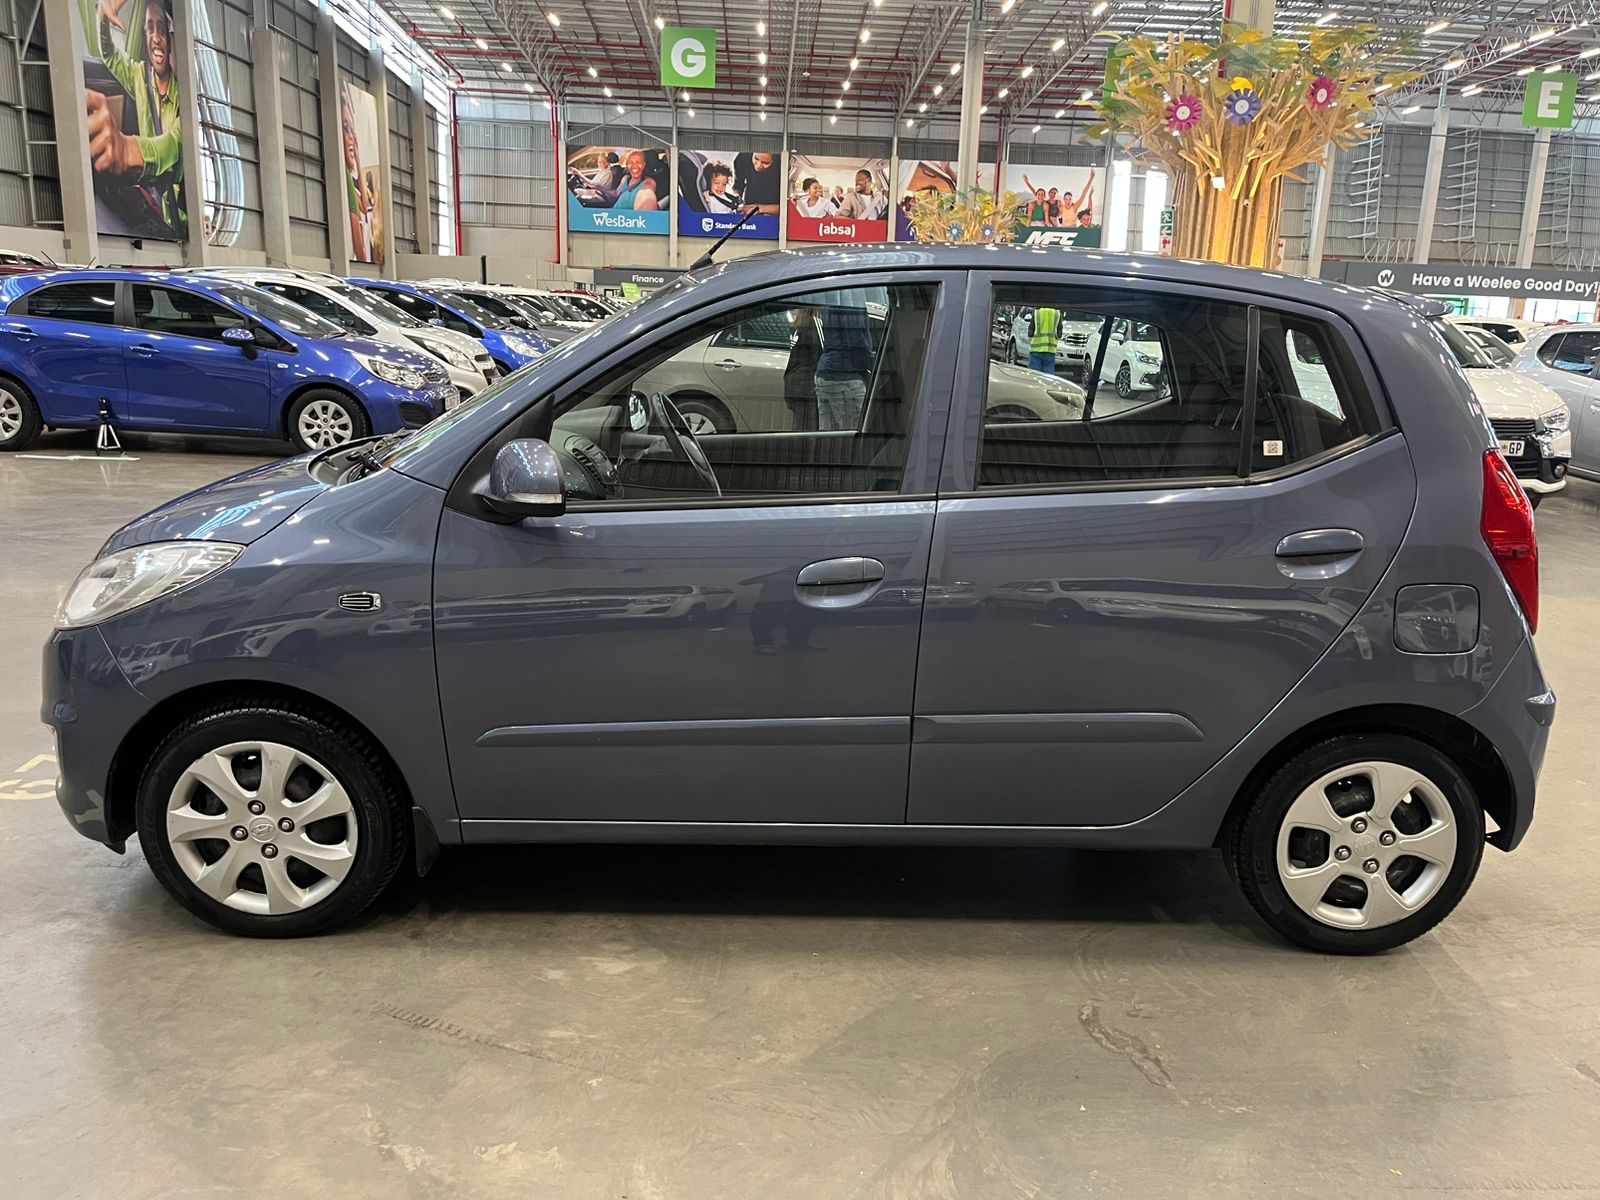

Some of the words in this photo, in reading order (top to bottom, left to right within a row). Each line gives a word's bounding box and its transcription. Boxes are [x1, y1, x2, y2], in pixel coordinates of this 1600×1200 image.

[671, 38, 706, 78] G
[1537, 81, 1563, 118] E
[592, 212, 647, 229] WesBank
[1025, 230, 1078, 246] MFC
[632, 274, 664, 284] Finance
[1412, 272, 1451, 287] Have
[1453, 276, 1464, 287] a
[1467, 275, 1521, 290] Weelee
[1524, 277, 1562, 292] Good
[1564, 280, 1600, 297] Day!
[1509, 441, 1522, 455] GP
